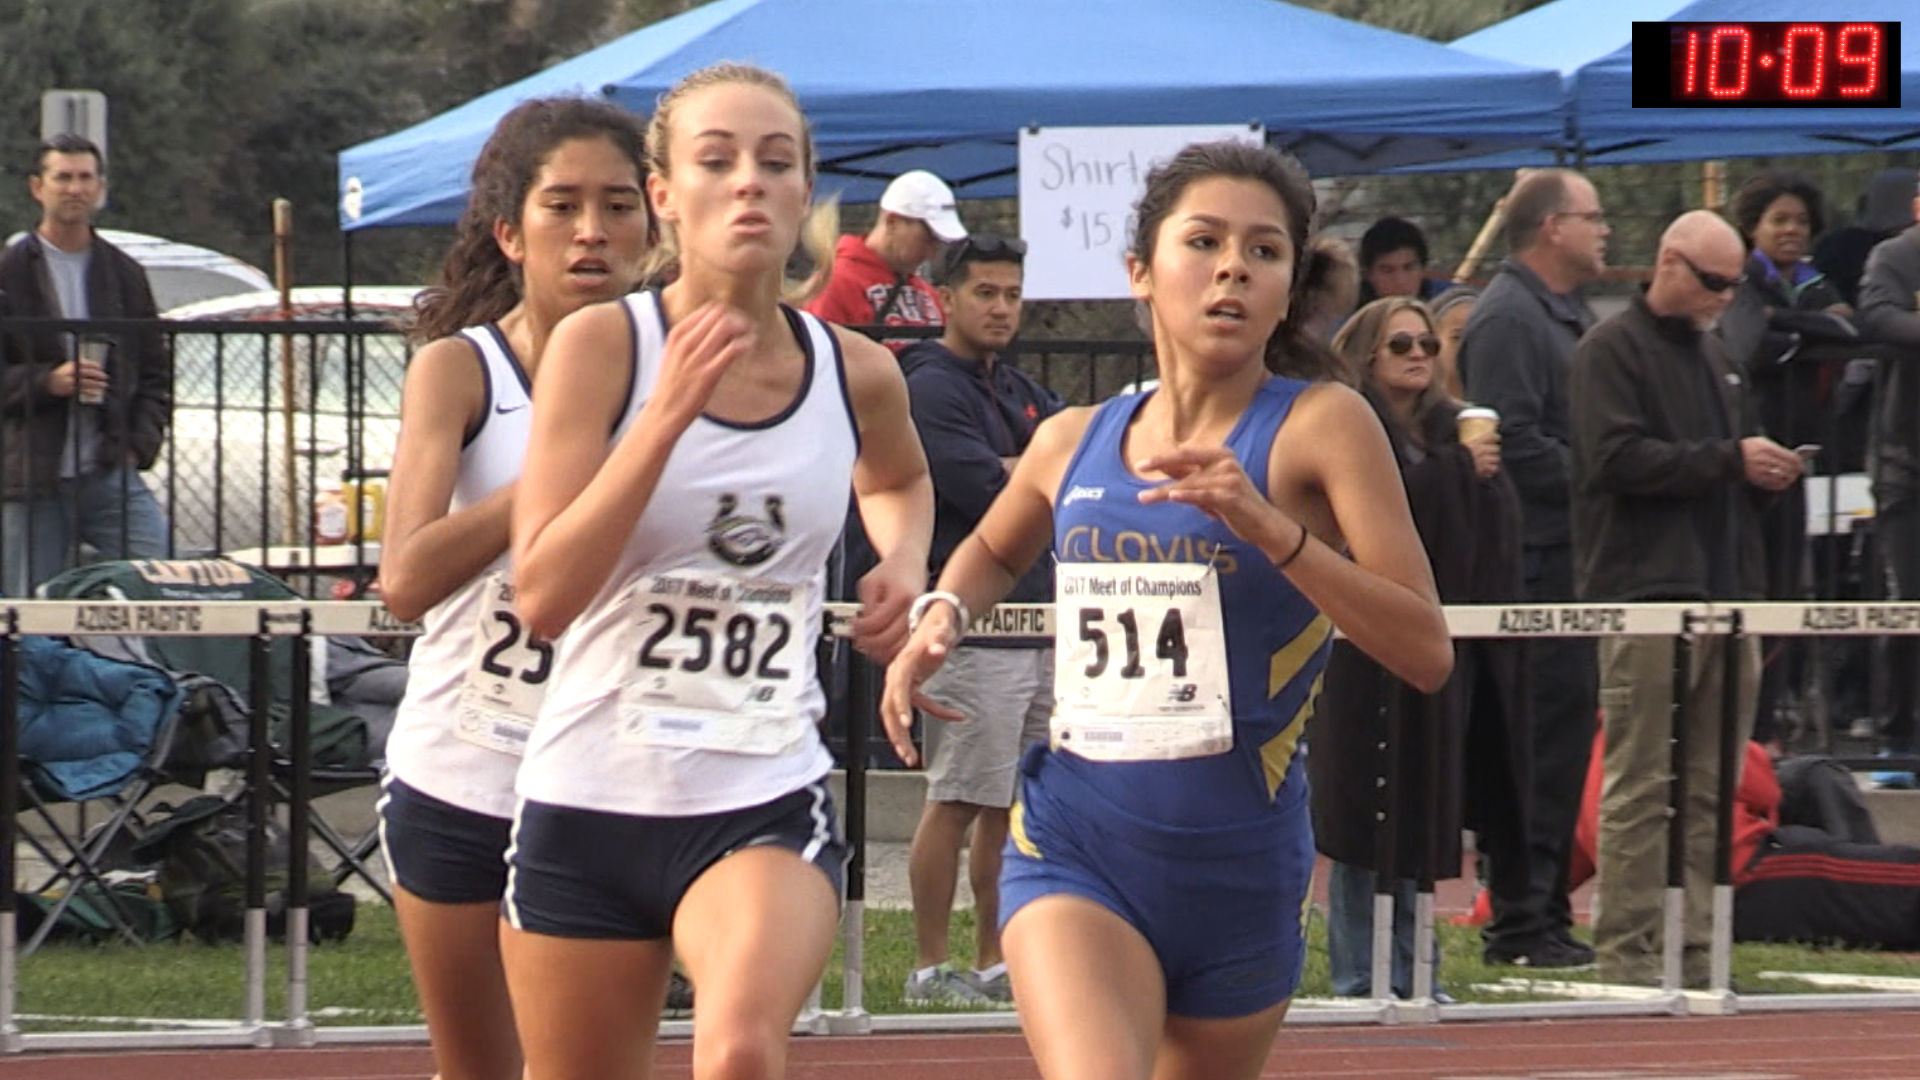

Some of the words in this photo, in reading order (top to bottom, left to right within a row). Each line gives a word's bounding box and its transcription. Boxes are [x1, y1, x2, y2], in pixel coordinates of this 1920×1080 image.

[1041, 142, 1142, 191] Shirt
[1063, 525, 1237, 574] CLOVIS
[1089, 576, 1117, 595] Meet
[1120, 576, 1132, 595] of
[1135, 577, 1202, 600] Champions
[76, 605, 131, 631] AZUSA
[137, 605, 201, 631] PACIFIC
[1500, 608, 1554, 632] AZUSA
[1560, 608, 1625, 632] PACIFIC
[1803, 607, 1858, 629] AZUSA
[1866, 607, 1920, 629] PACIF
[638, 603, 791, 679] 2582
[1079, 607, 1189, 679] 514
